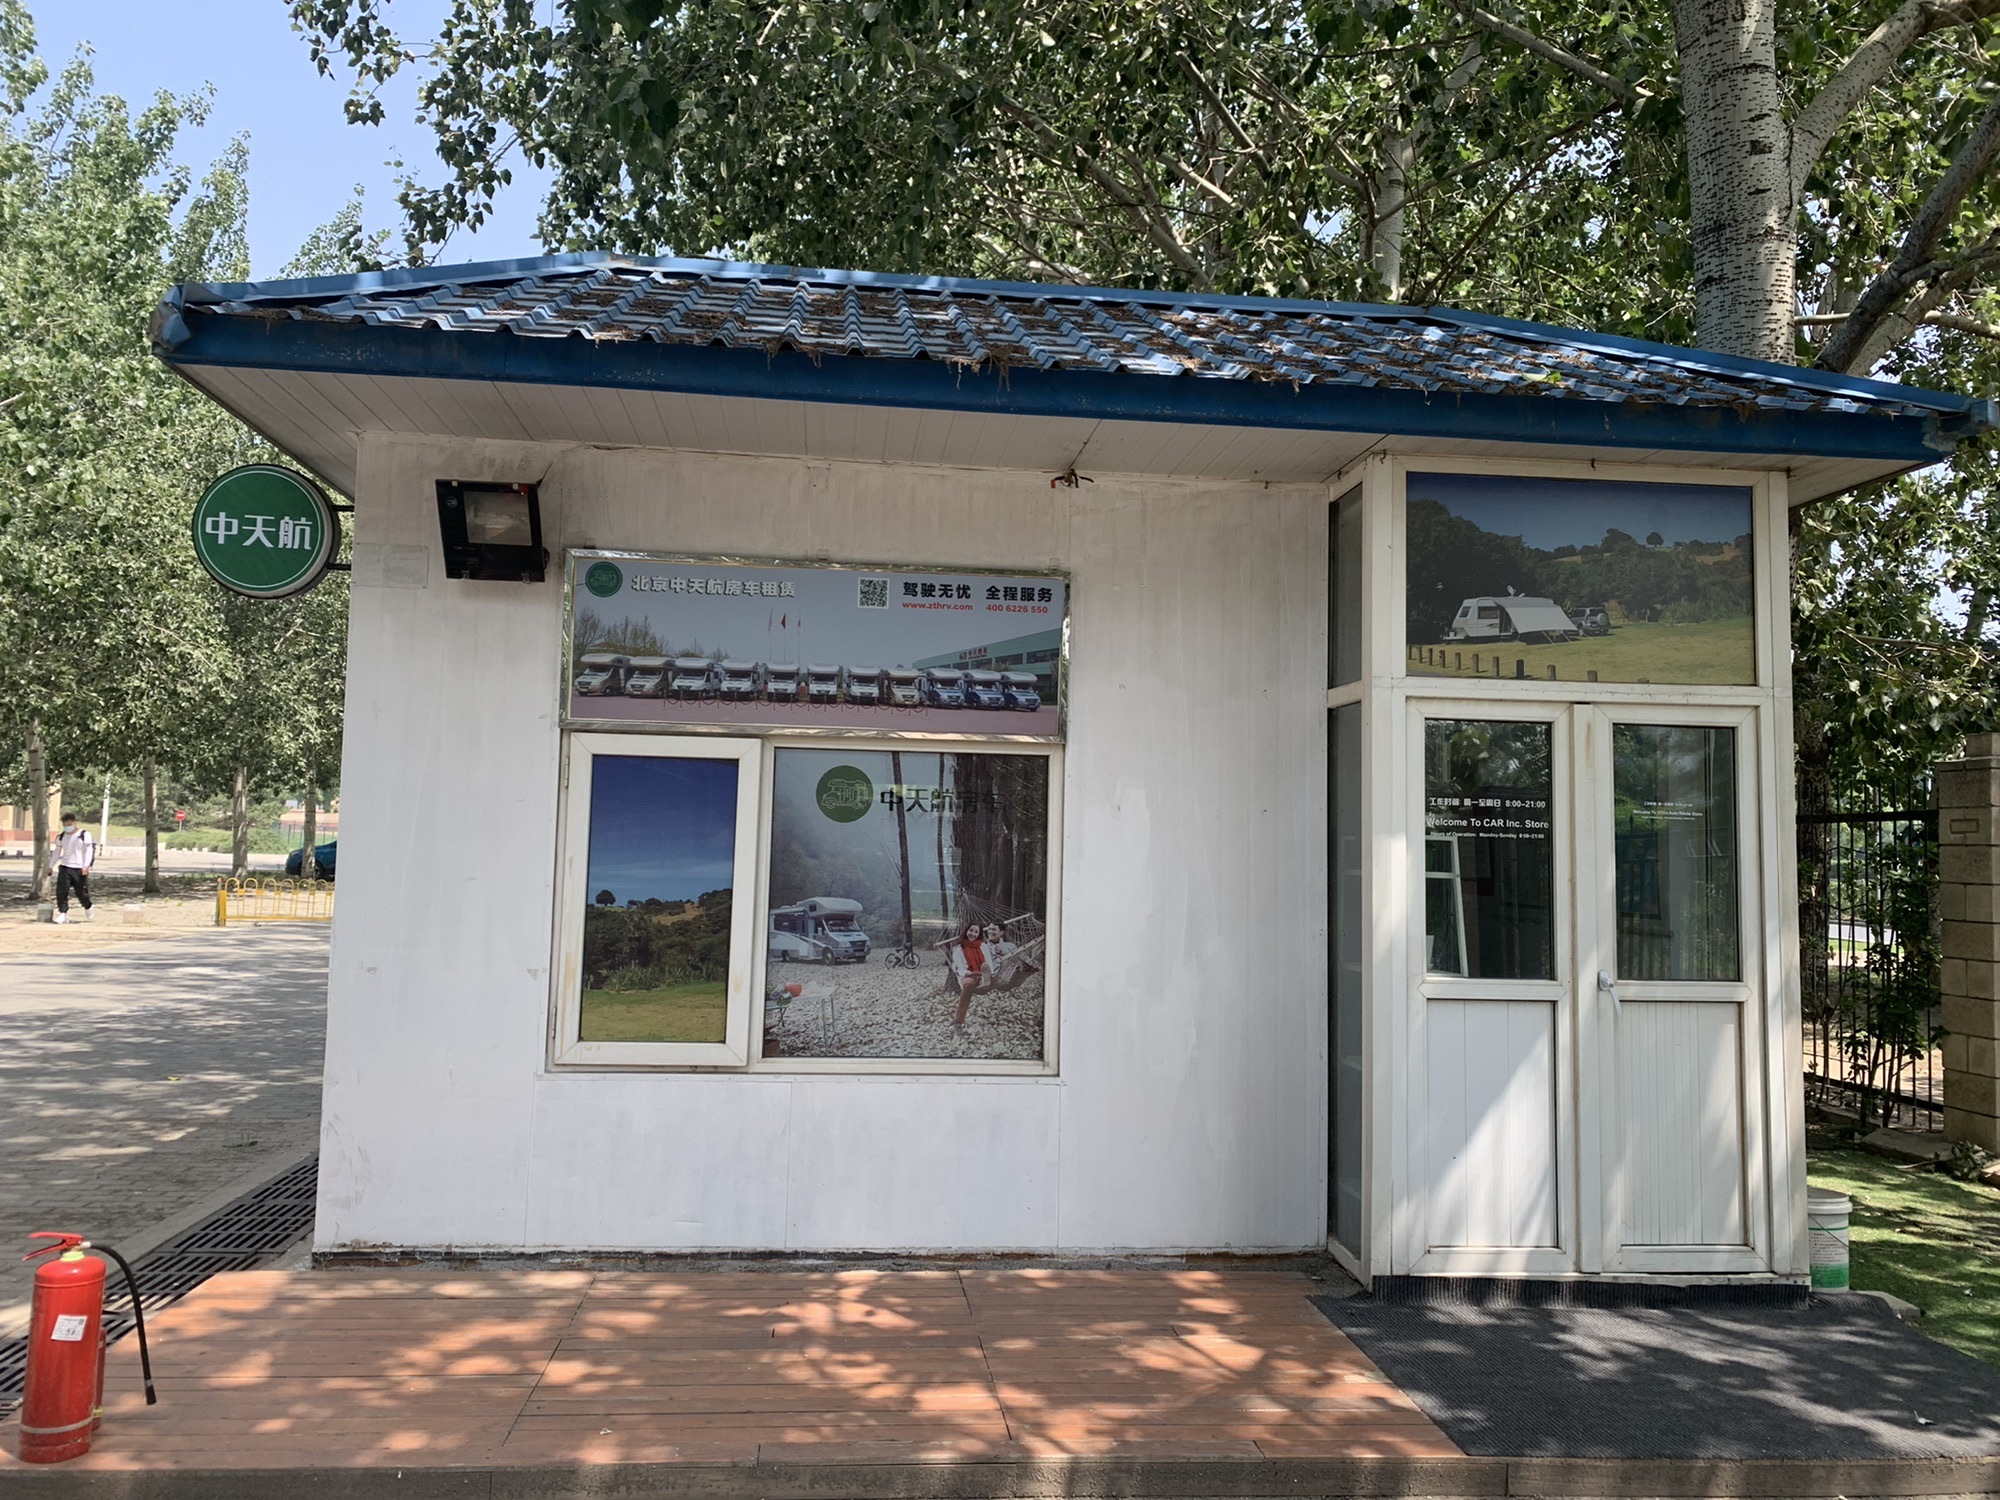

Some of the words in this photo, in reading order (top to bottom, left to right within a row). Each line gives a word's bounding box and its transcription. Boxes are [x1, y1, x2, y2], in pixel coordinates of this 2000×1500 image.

[205, 511, 313, 550] 中天航
[631, 574, 796, 598] 北京中天航房车租赁
[902, 581, 972, 600] 驾驶无忧
[985, 585, 1053, 603] 全程服务
[902, 602, 973, 611] www.zthrv.com
[985, 604, 1004, 612] 400
[1006, 604, 1029, 613] 6226
[1031, 605, 1048, 614] 550
[1505, 800, 1546, 808] 8:00-21:00
[1426, 817, 1468, 827] Welcome
[1470, 818, 1481, 827] To
[1483, 818, 1504, 828] CAR
[1506, 819, 1523, 828] Inc.
[1525, 819, 1549, 829] Store
